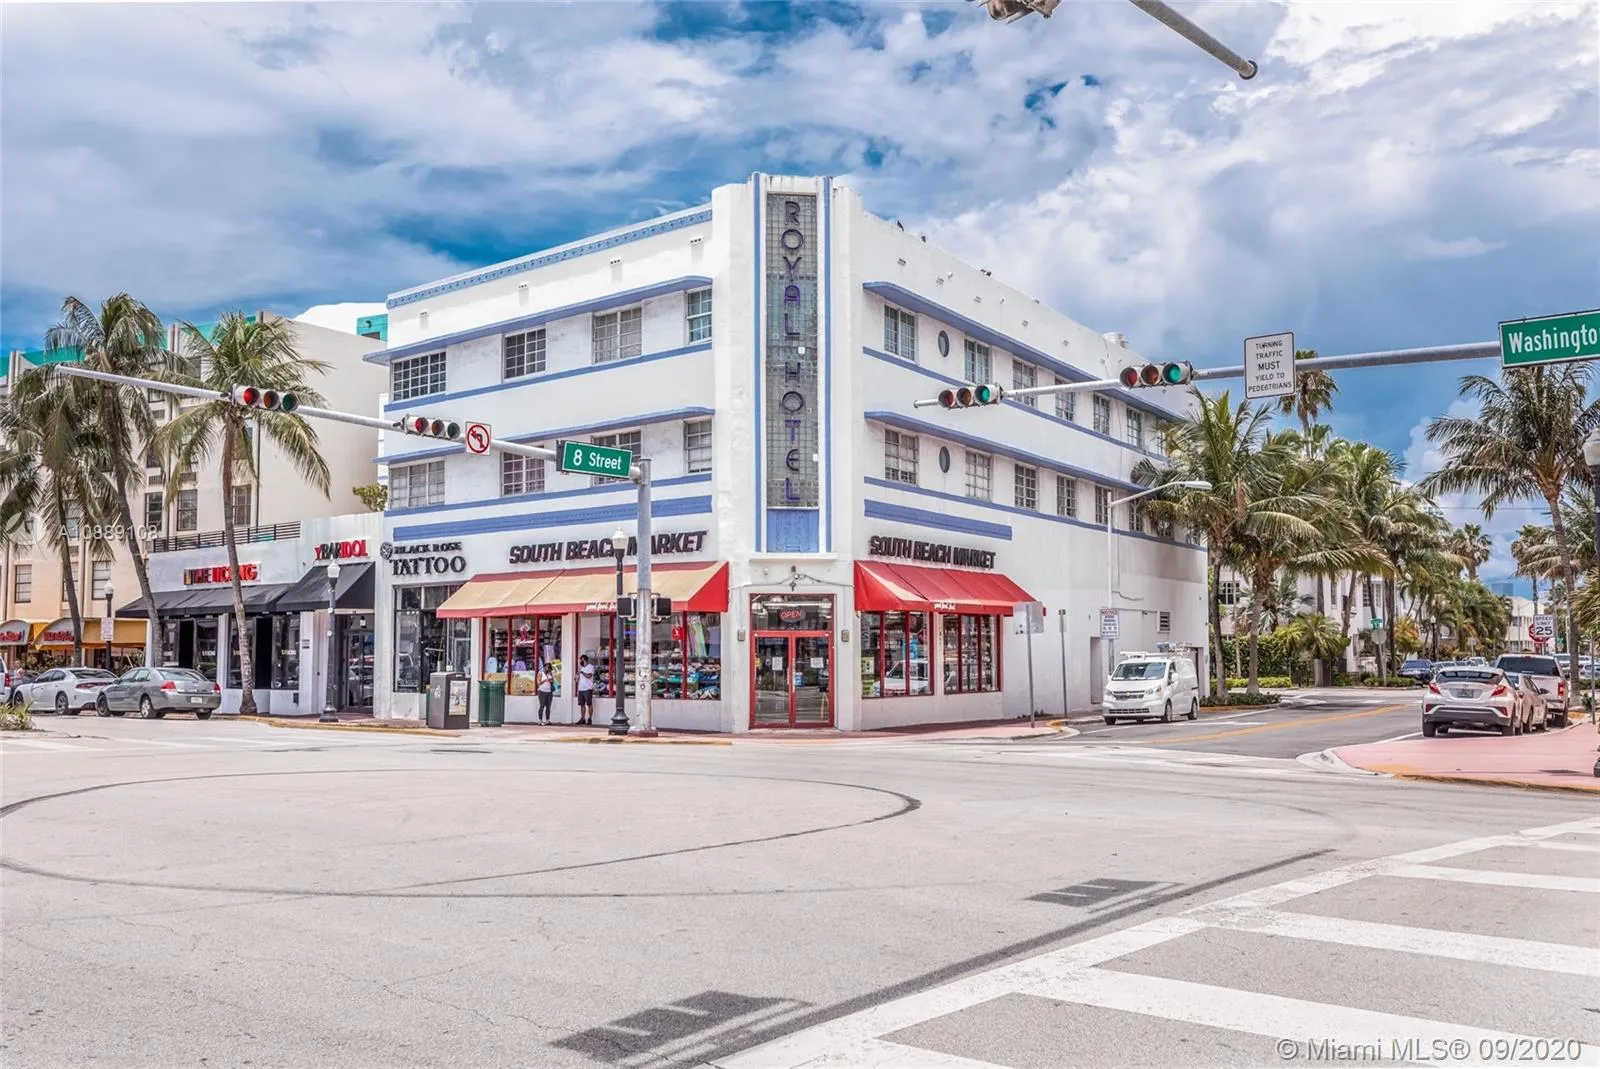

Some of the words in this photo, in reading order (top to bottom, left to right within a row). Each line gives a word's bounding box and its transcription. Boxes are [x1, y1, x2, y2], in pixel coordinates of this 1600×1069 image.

[780, 200, 804, 337] ROYAL
[1255, 340, 1283, 349] TURNING
[1508, 323, 1600, 354] Washingto
[1256, 350, 1283, 360] TRAFFIC
[1258, 360, 1280, 371] MUST
[1255, 373, 1274, 381] YIELD
[1276, 371, 1285, 379] TO
[1248, 381, 1292, 393] PEDESTRIANS
[781, 361, 804, 501] HOTEL
[573, 449, 582, 466] 8
[588, 452, 622, 470] Street
[394, 544, 431, 555] BLACK
[432, 542, 462, 552] ROSE
[509, 541, 563, 564] SOUTH
[565, 538, 615, 561] BEAC
[870, 535, 912, 558] SOUTH
[913, 540, 952, 564] BEACH
[952, 547, 996, 569] MARKET
[389, 555, 466, 576] TATTOO
[780, 610, 802, 619] OPEN
[1536, 626, 1552, 635] 25
